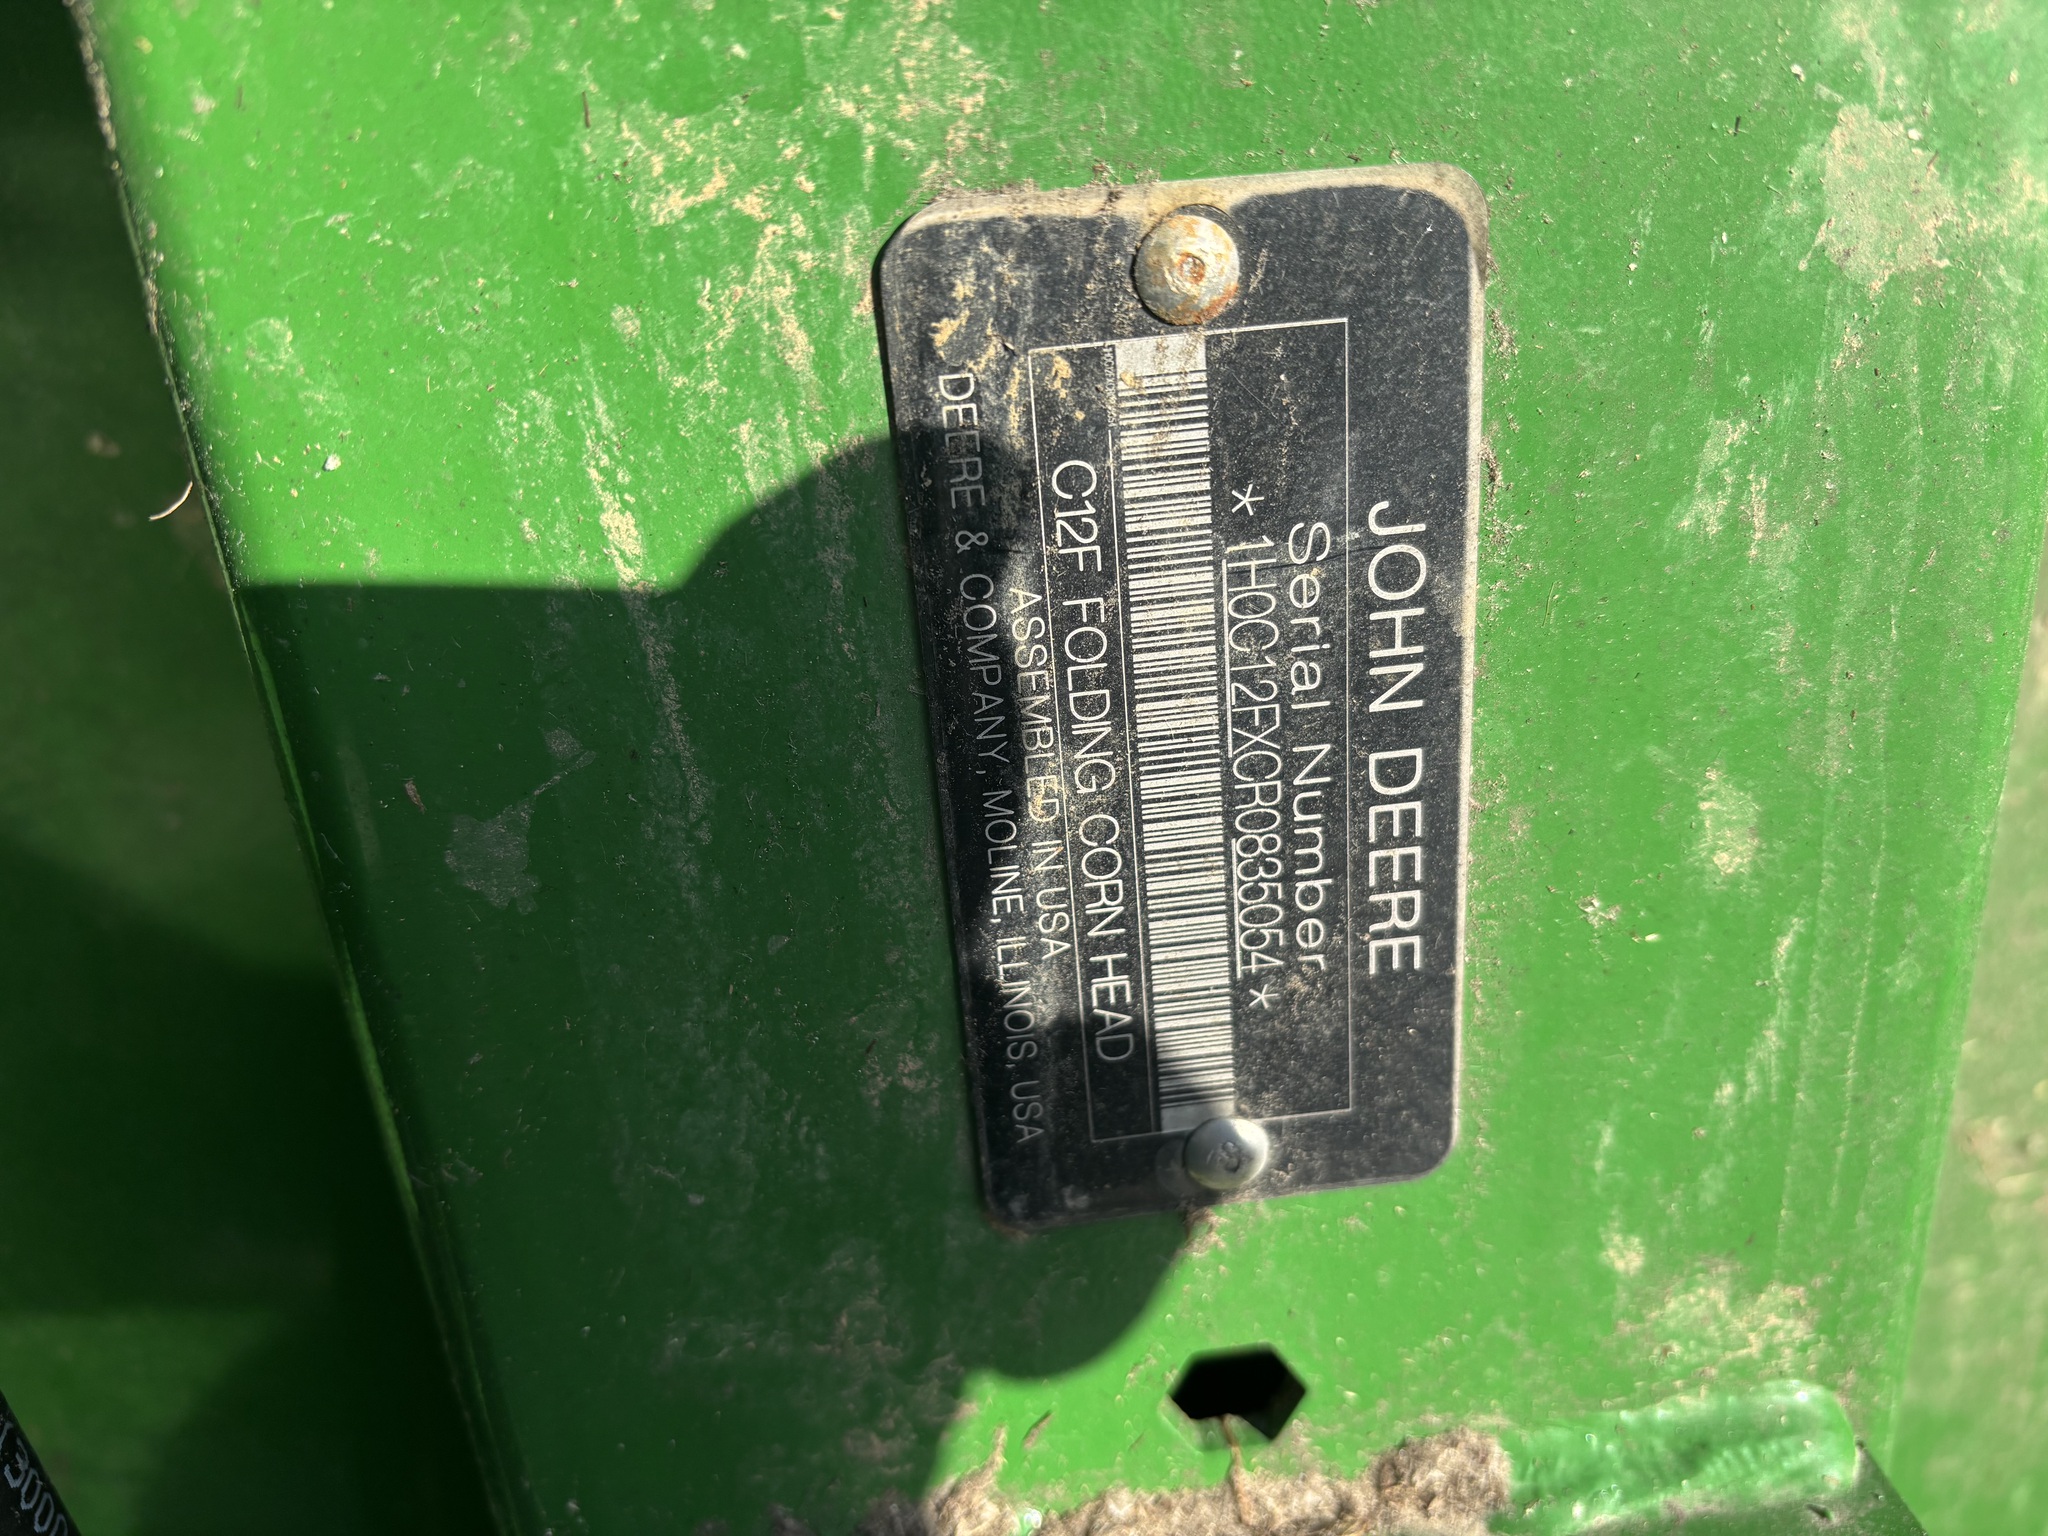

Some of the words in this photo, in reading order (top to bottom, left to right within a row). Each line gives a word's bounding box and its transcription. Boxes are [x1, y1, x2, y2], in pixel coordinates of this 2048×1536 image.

[938, 373, 986, 510] DEERE
[955, 530, 989, 554] &
[1051, 459, 1103, 572] C12F
[959, 573, 1011, 775] COMPANY,
[1288, 522, 1331, 709] Serial
[1368, 500, 1427, 713] JOHN
[1009, 587, 1061, 823] ASSEMBLED
[1062, 597, 1117, 794] FOLDING
[1224, 535, 1285, 974] 1H0C12FXCR0835054
[982, 789, 1024, 924] MOLINE,
[1031, 839, 1066, 873] IN
[1036, 887, 1072, 960] USA
[1078, 813, 1128, 937] CORN
[1292, 743, 1334, 972] Number
[1368, 748, 1424, 975] DEERE
[996, 936, 1039, 1069] ILLINOIS,
[1089, 953, 1135, 1061] HEAD
[1010, 1080, 1045, 1143] USA
